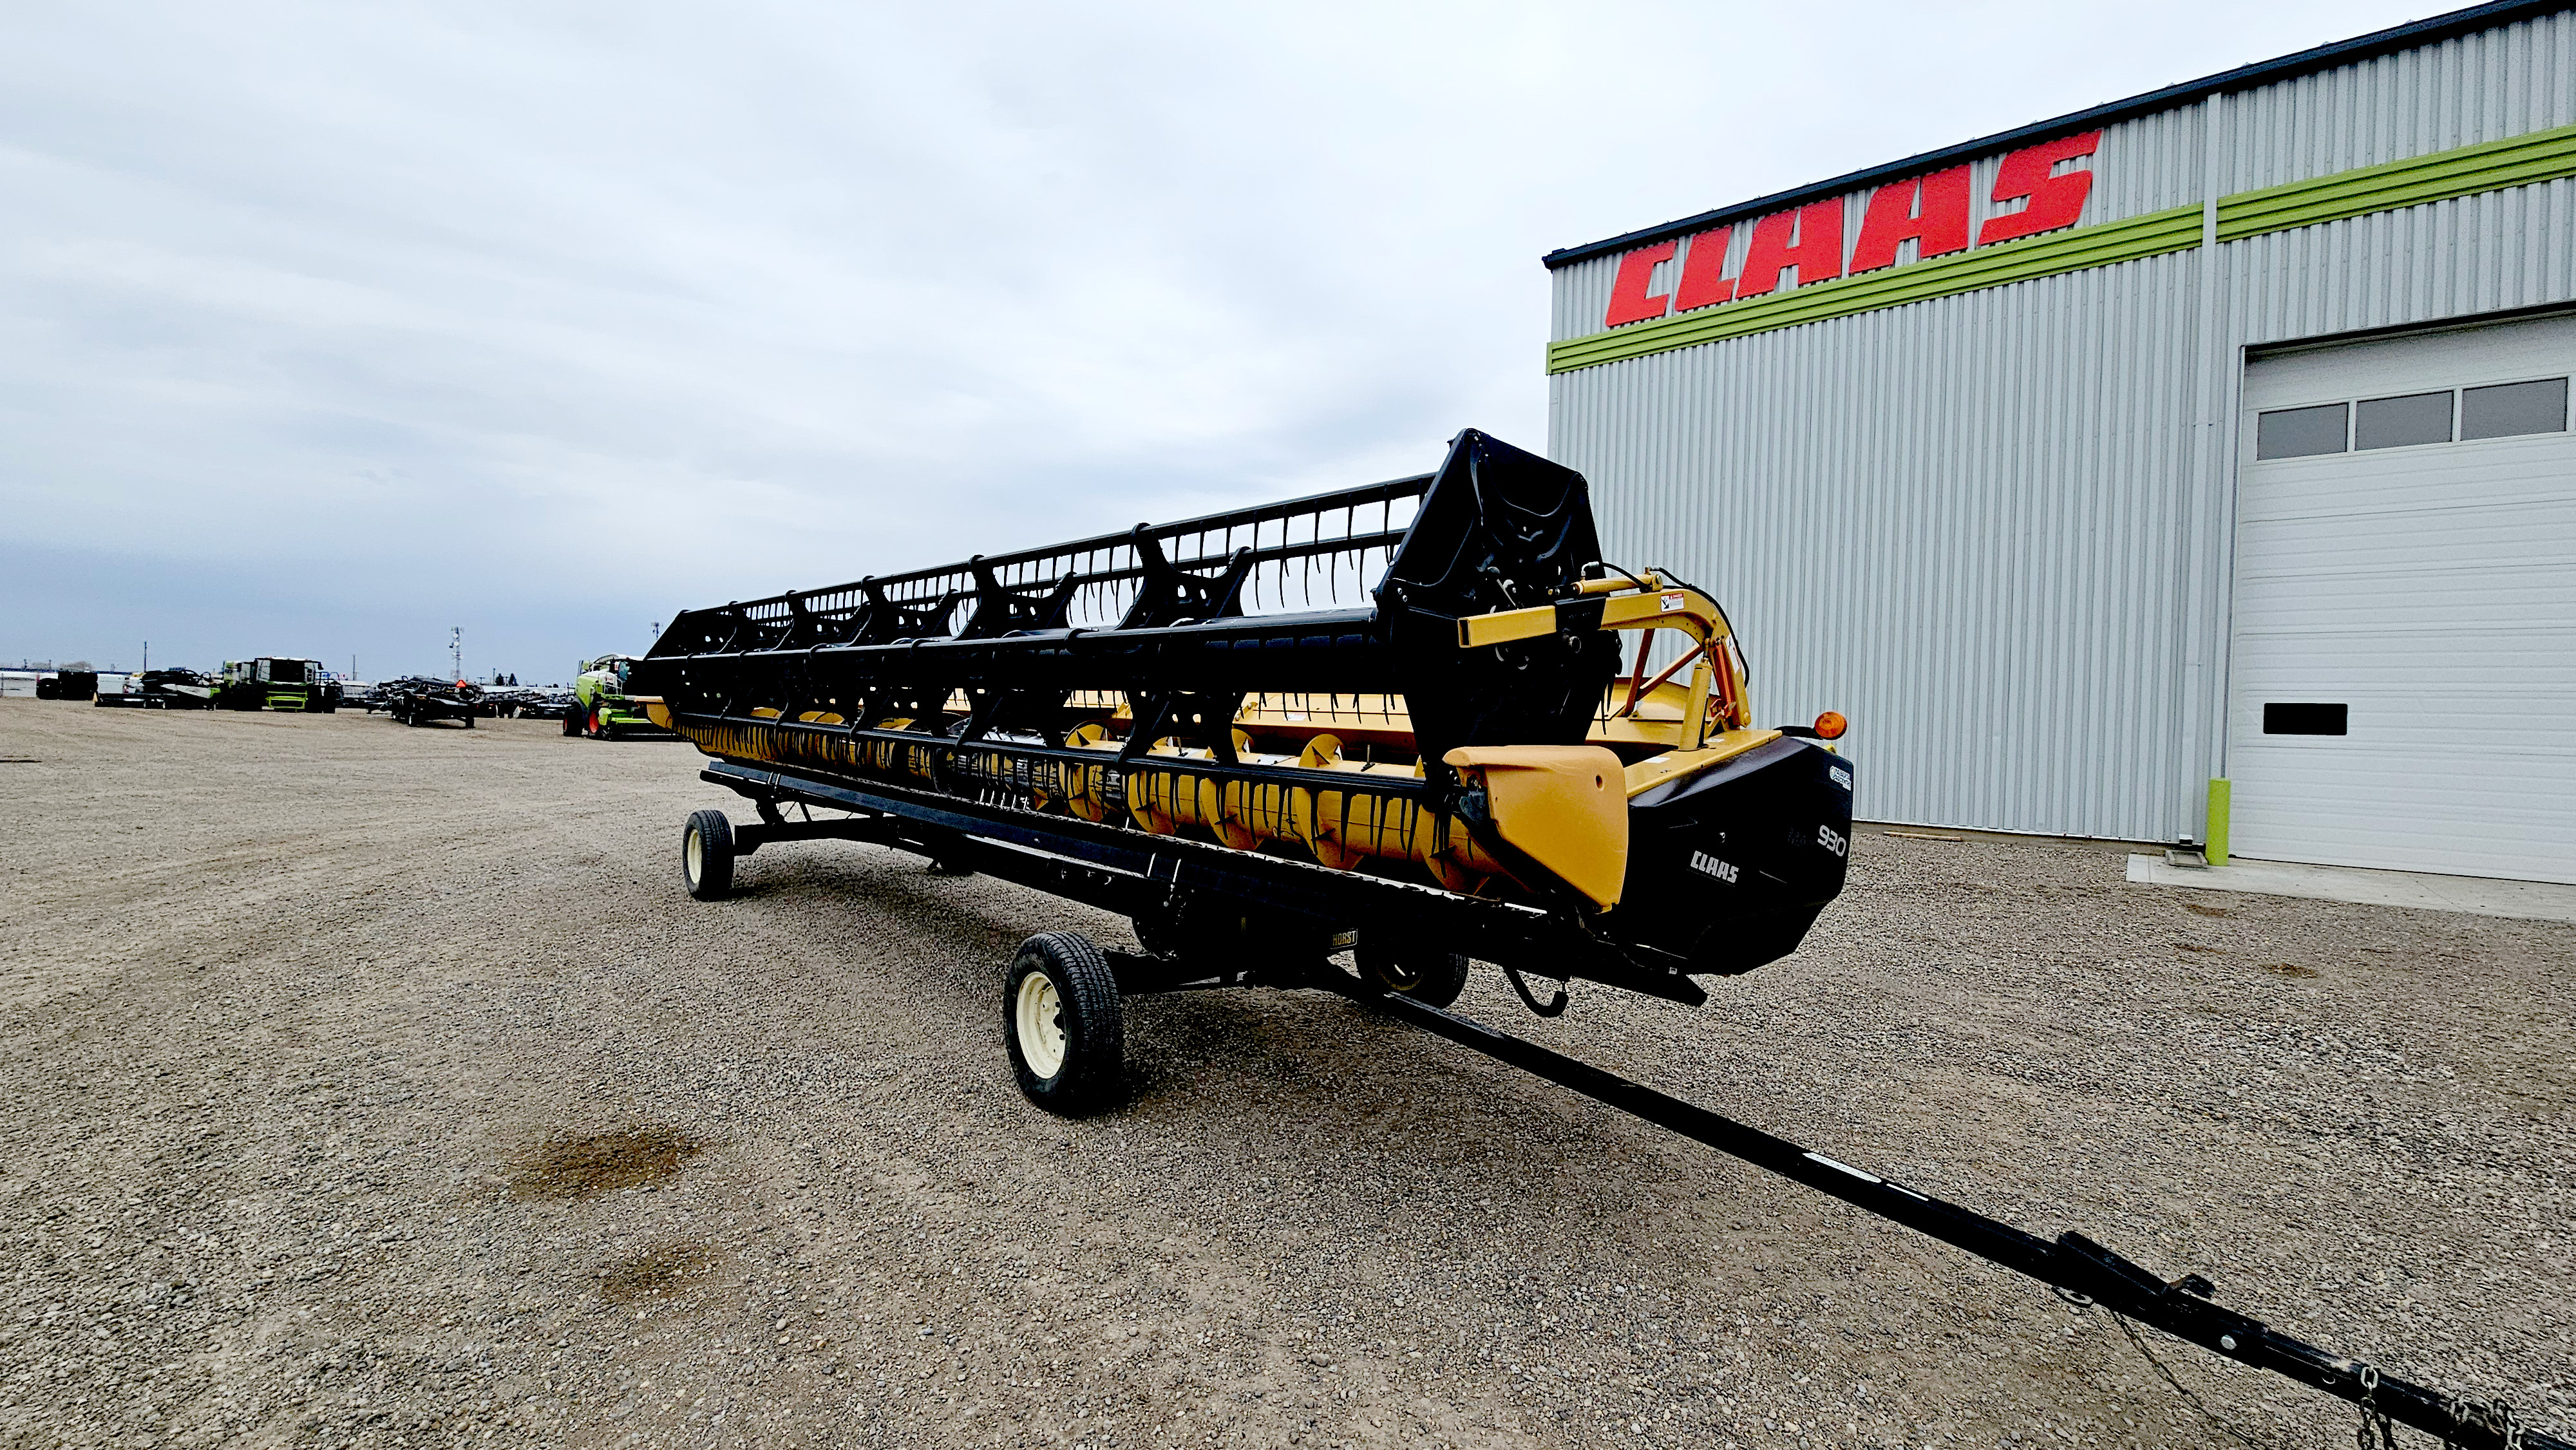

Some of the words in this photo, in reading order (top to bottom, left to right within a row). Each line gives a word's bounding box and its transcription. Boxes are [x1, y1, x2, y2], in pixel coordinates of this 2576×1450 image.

[1605, 129, 2103, 327] CLAAS
[1817, 824, 1846, 856] 930
[1690, 850, 1739, 883] CLAAS
[1332, 930, 1356, 946] HORST
